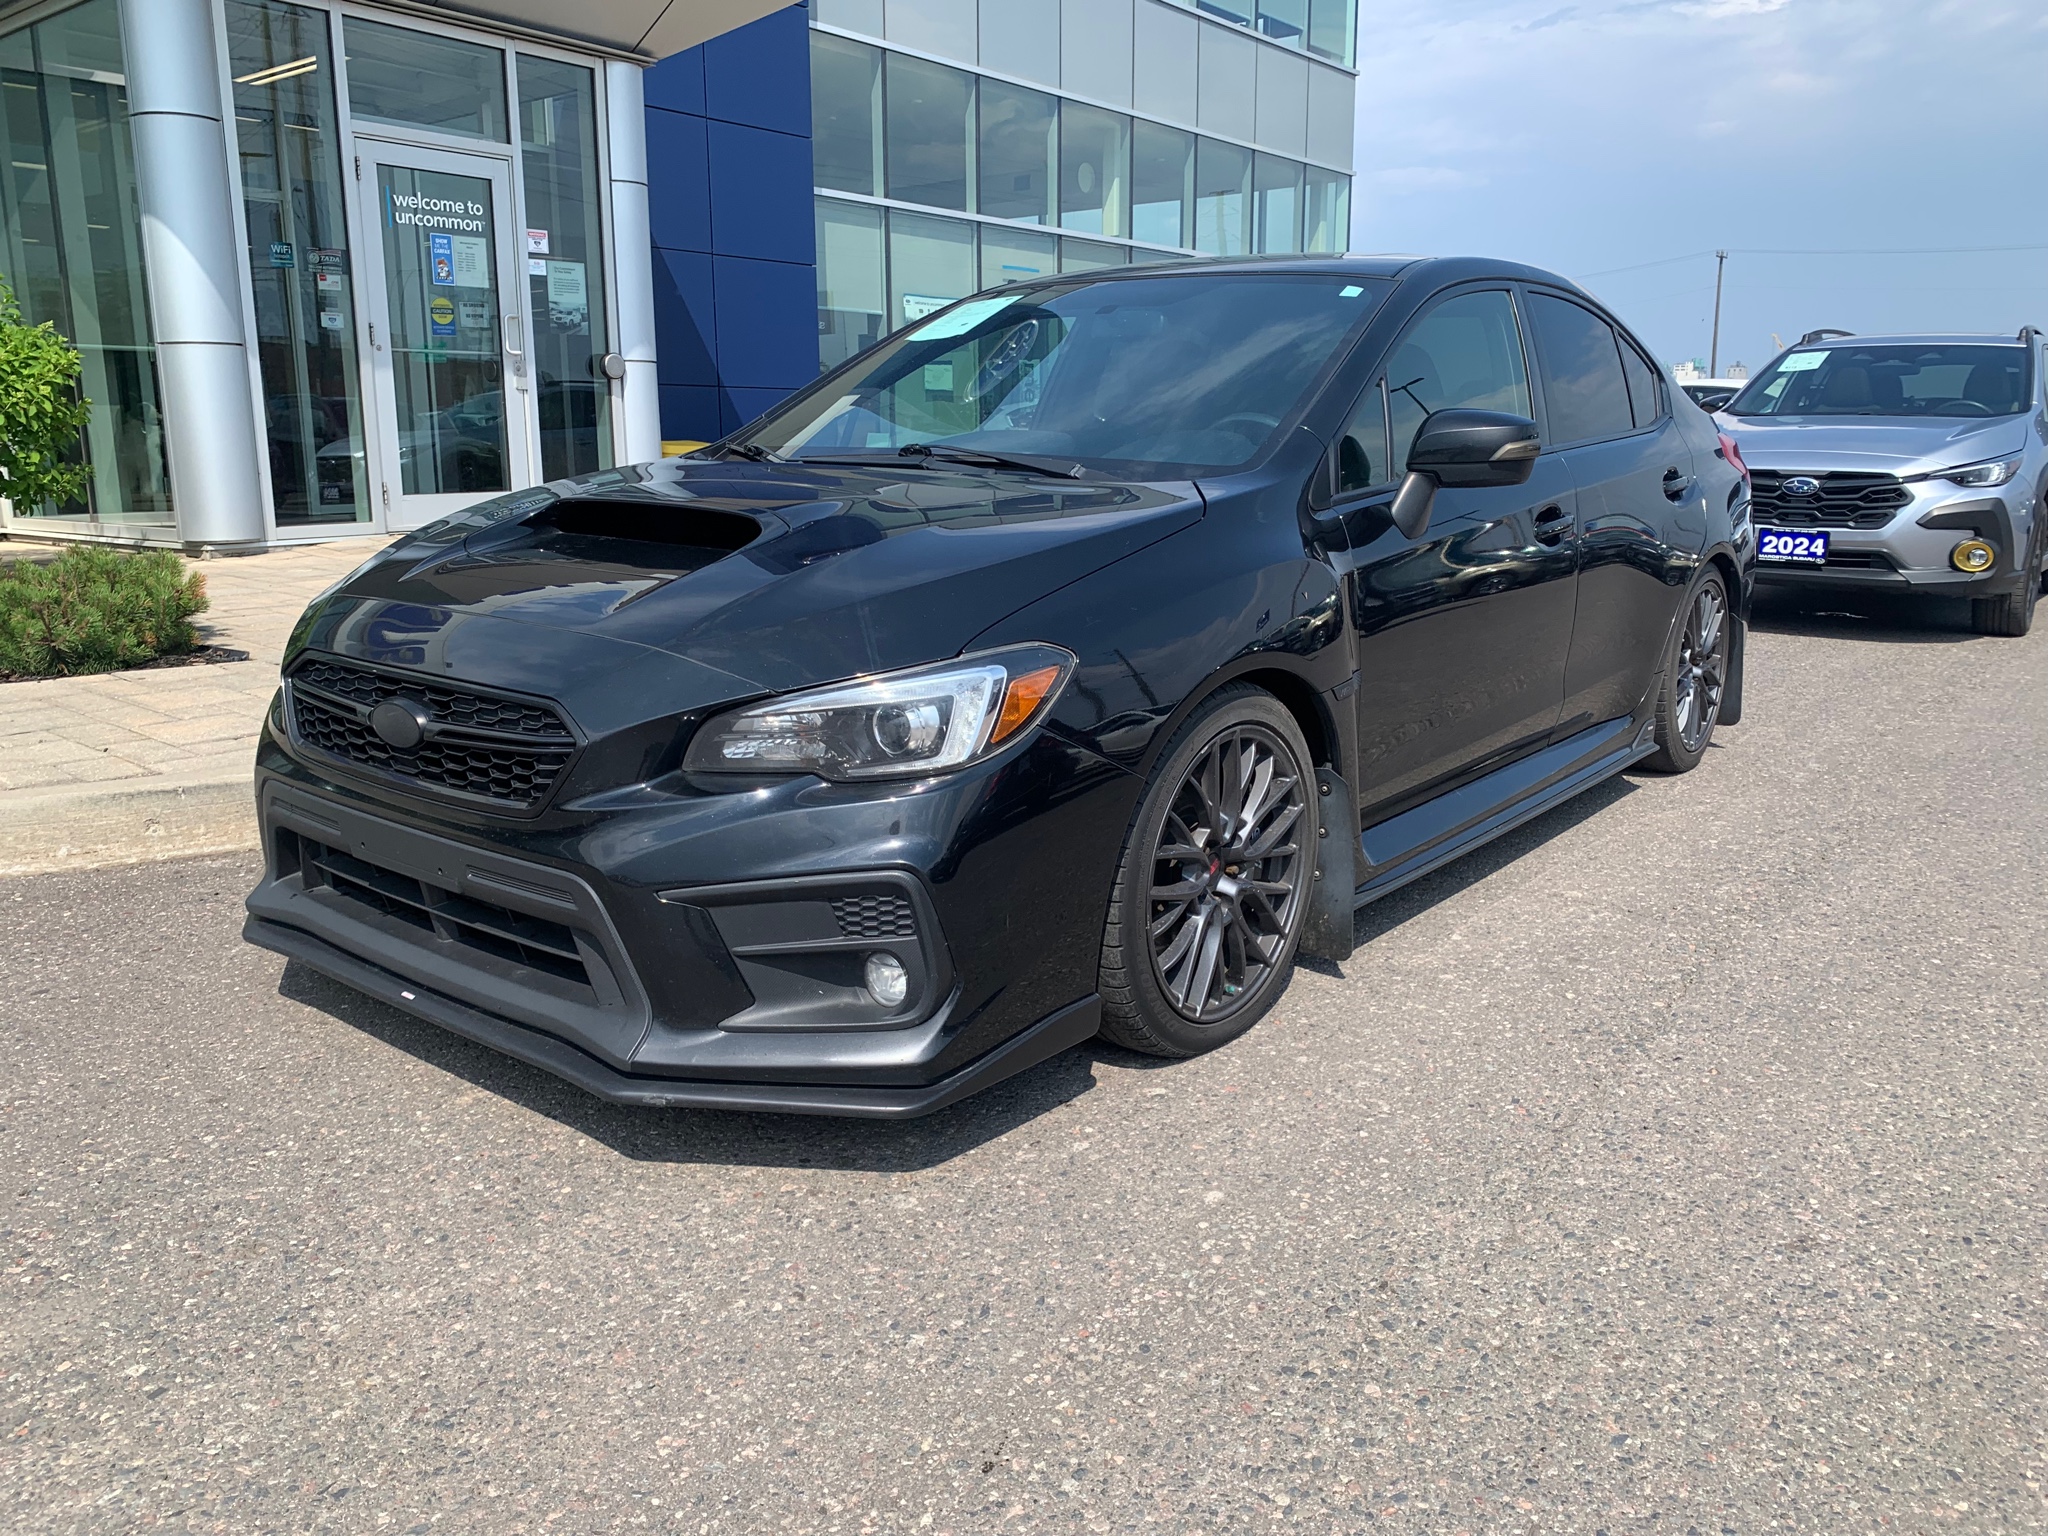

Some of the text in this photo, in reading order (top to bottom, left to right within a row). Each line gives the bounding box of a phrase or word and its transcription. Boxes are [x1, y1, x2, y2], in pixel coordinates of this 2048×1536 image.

[393, 192, 483, 215] welcome to
[395, 212, 482, 232] uncommon
[270, 244, 291, 254] WiFi
[1762, 535, 1825, 556] 2024
